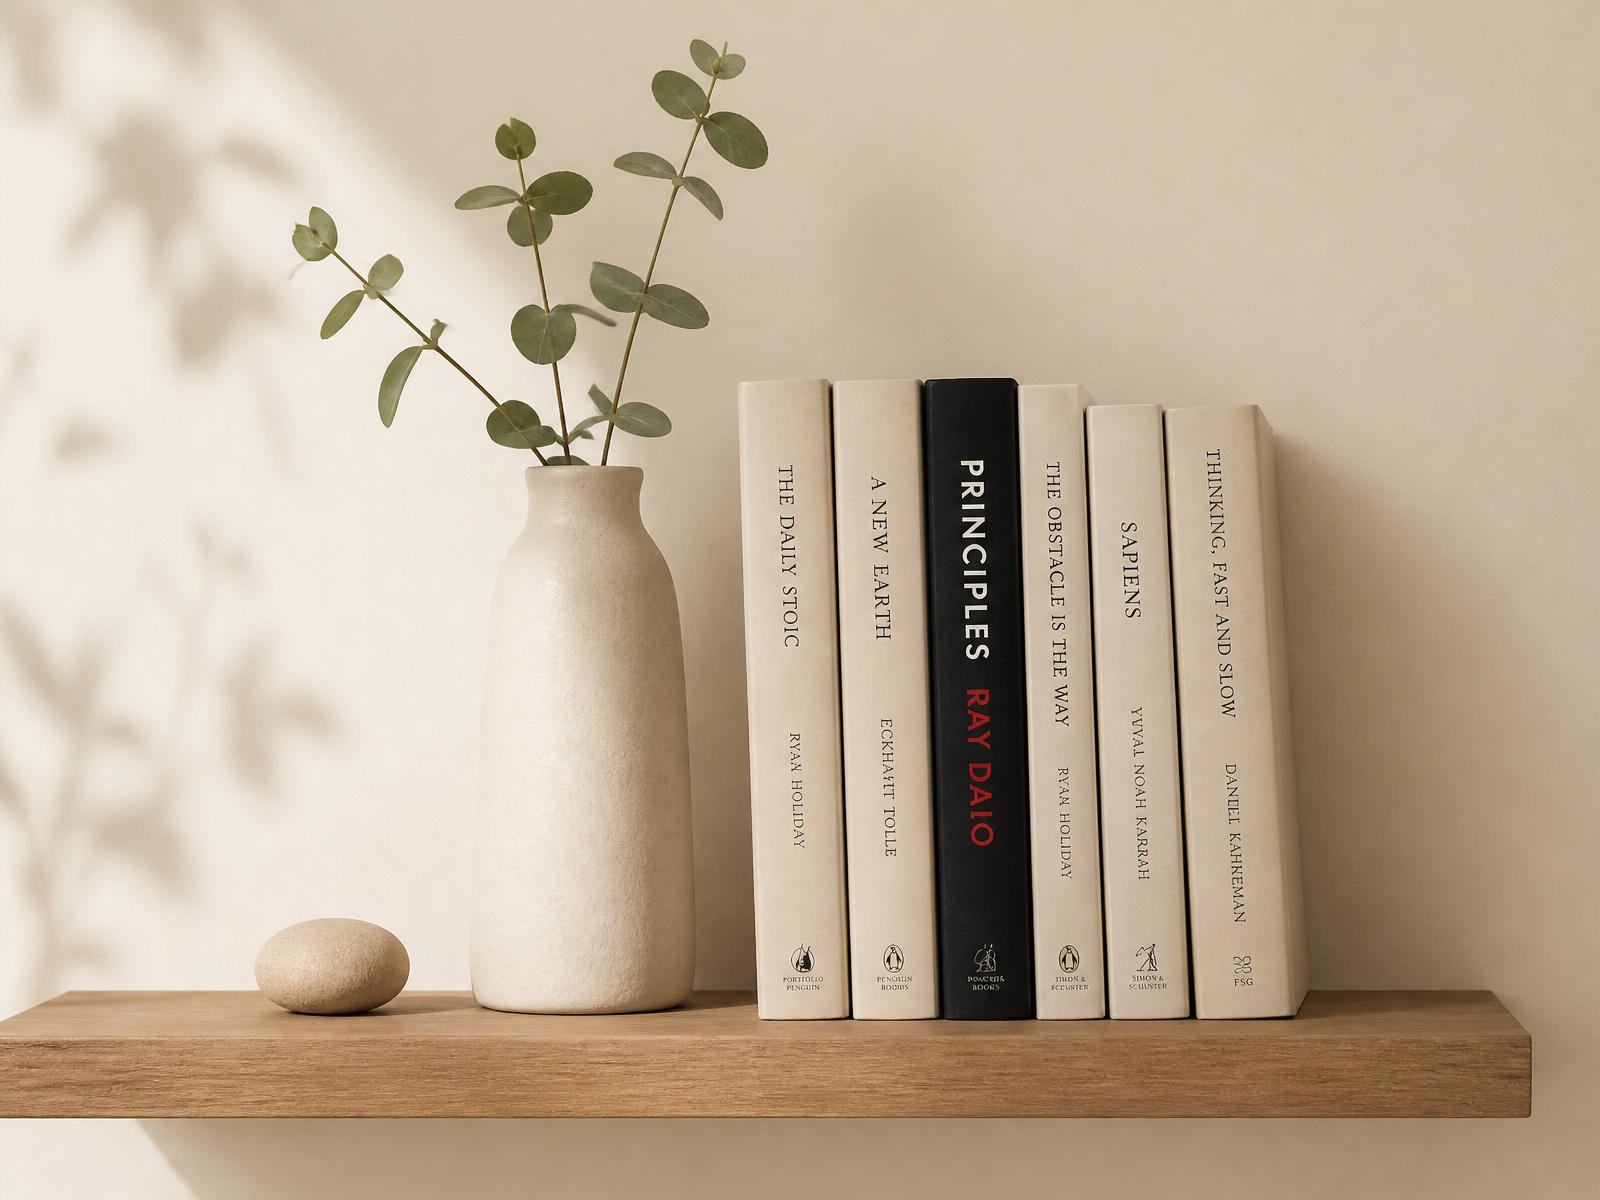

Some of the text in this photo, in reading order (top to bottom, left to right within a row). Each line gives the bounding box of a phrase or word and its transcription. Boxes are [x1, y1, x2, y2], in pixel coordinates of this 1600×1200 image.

[779, 465, 799, 647] THE DAILY STOIC
[871, 476, 891, 639] A NEW EARTH
[961, 460, 989, 659] PRINCIPLES
[1047, 462, 1069, 726] THE OBSTACLE IS THE WAY
[1121, 523, 1141, 618] SAPIENS
[1207, 449, 1235, 717] THINKING, FAST AND SLOW
[790, 733, 805, 848] RYAN HOLIDAY
[884, 807, 896, 856] TOLLE
[967, 689, 994, 846] RAY DAIO
[1058, 768, 1072, 878] RYAN HOLIDAY
[1134, 765, 1146, 808] NOAH
[1136, 817, 1149, 879] KARRAH
